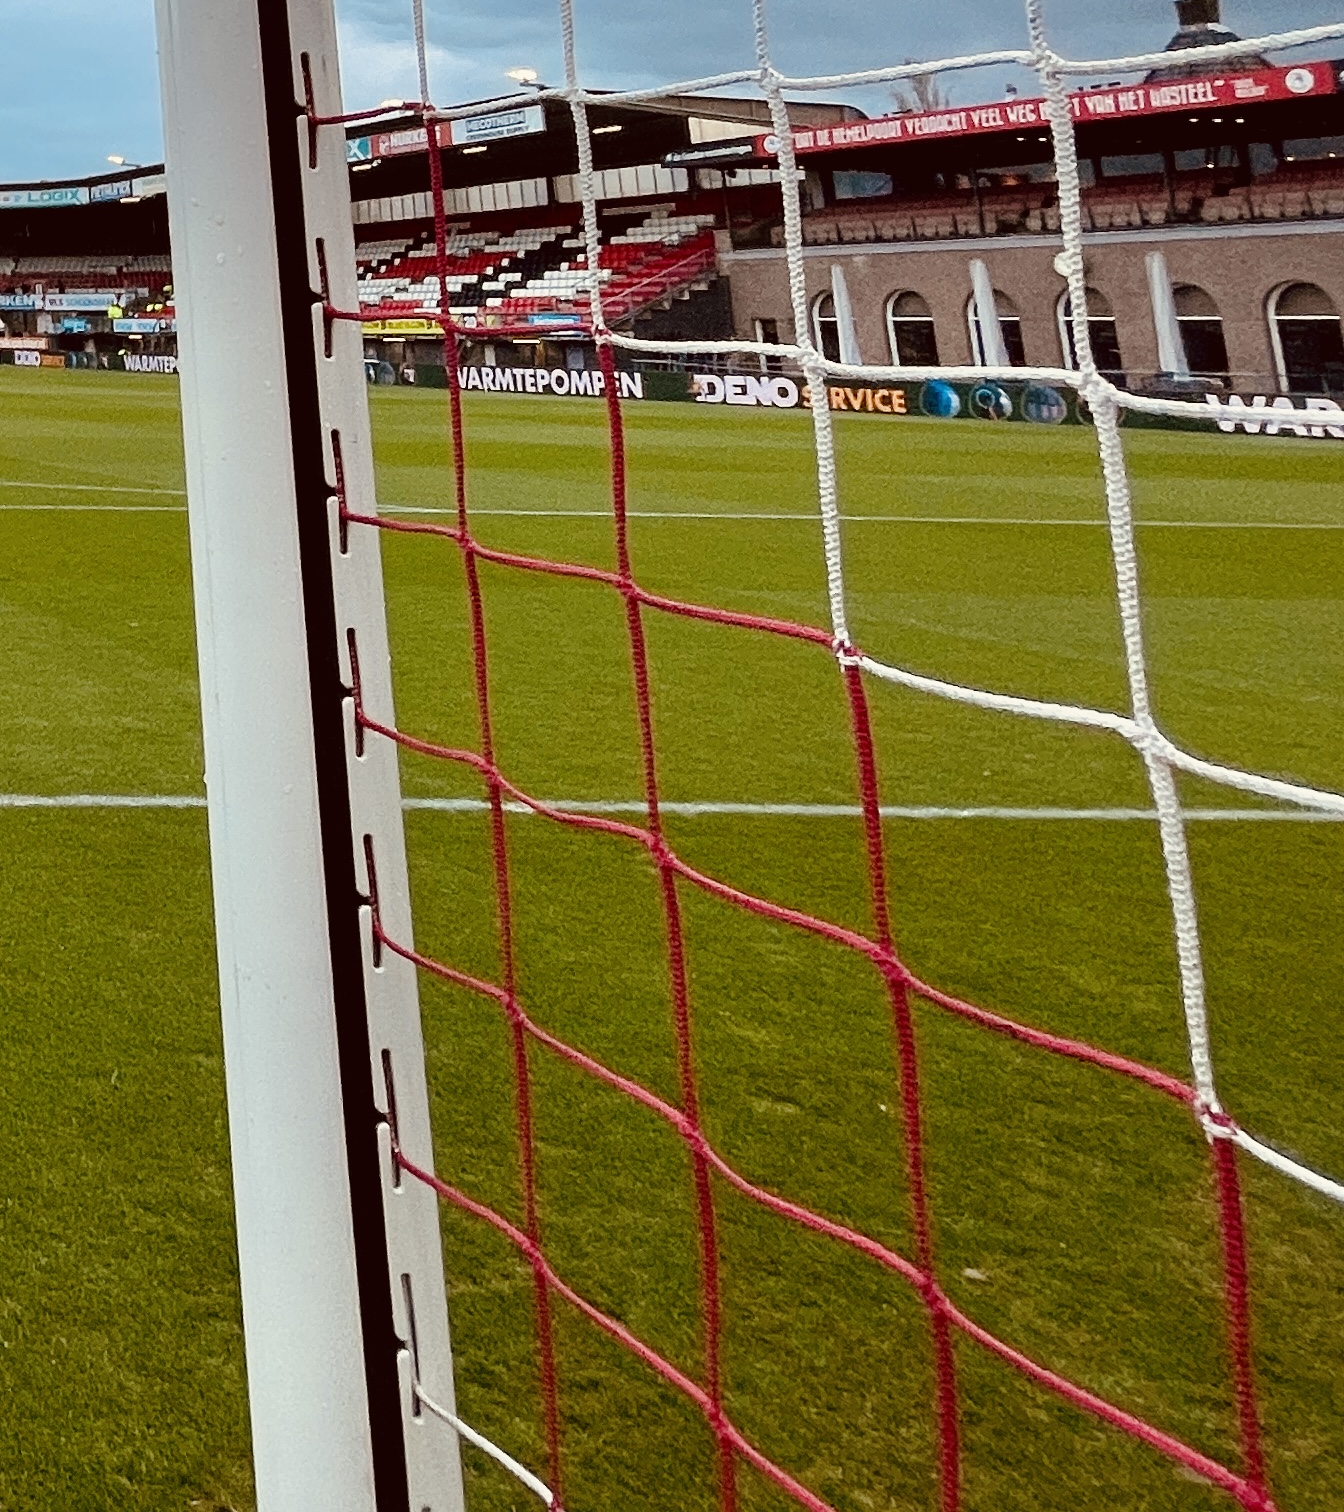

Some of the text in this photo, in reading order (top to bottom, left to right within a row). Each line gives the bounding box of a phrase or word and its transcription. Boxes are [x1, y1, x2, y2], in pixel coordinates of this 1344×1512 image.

[970, 107, 1004, 128] VEEL
[1005, 103, 1036, 123] WEG
[1118, 89, 1145, 112] HET
[27, 188, 83, 205] LOGIX
[694, 374, 907, 414] DENO SRVICE
